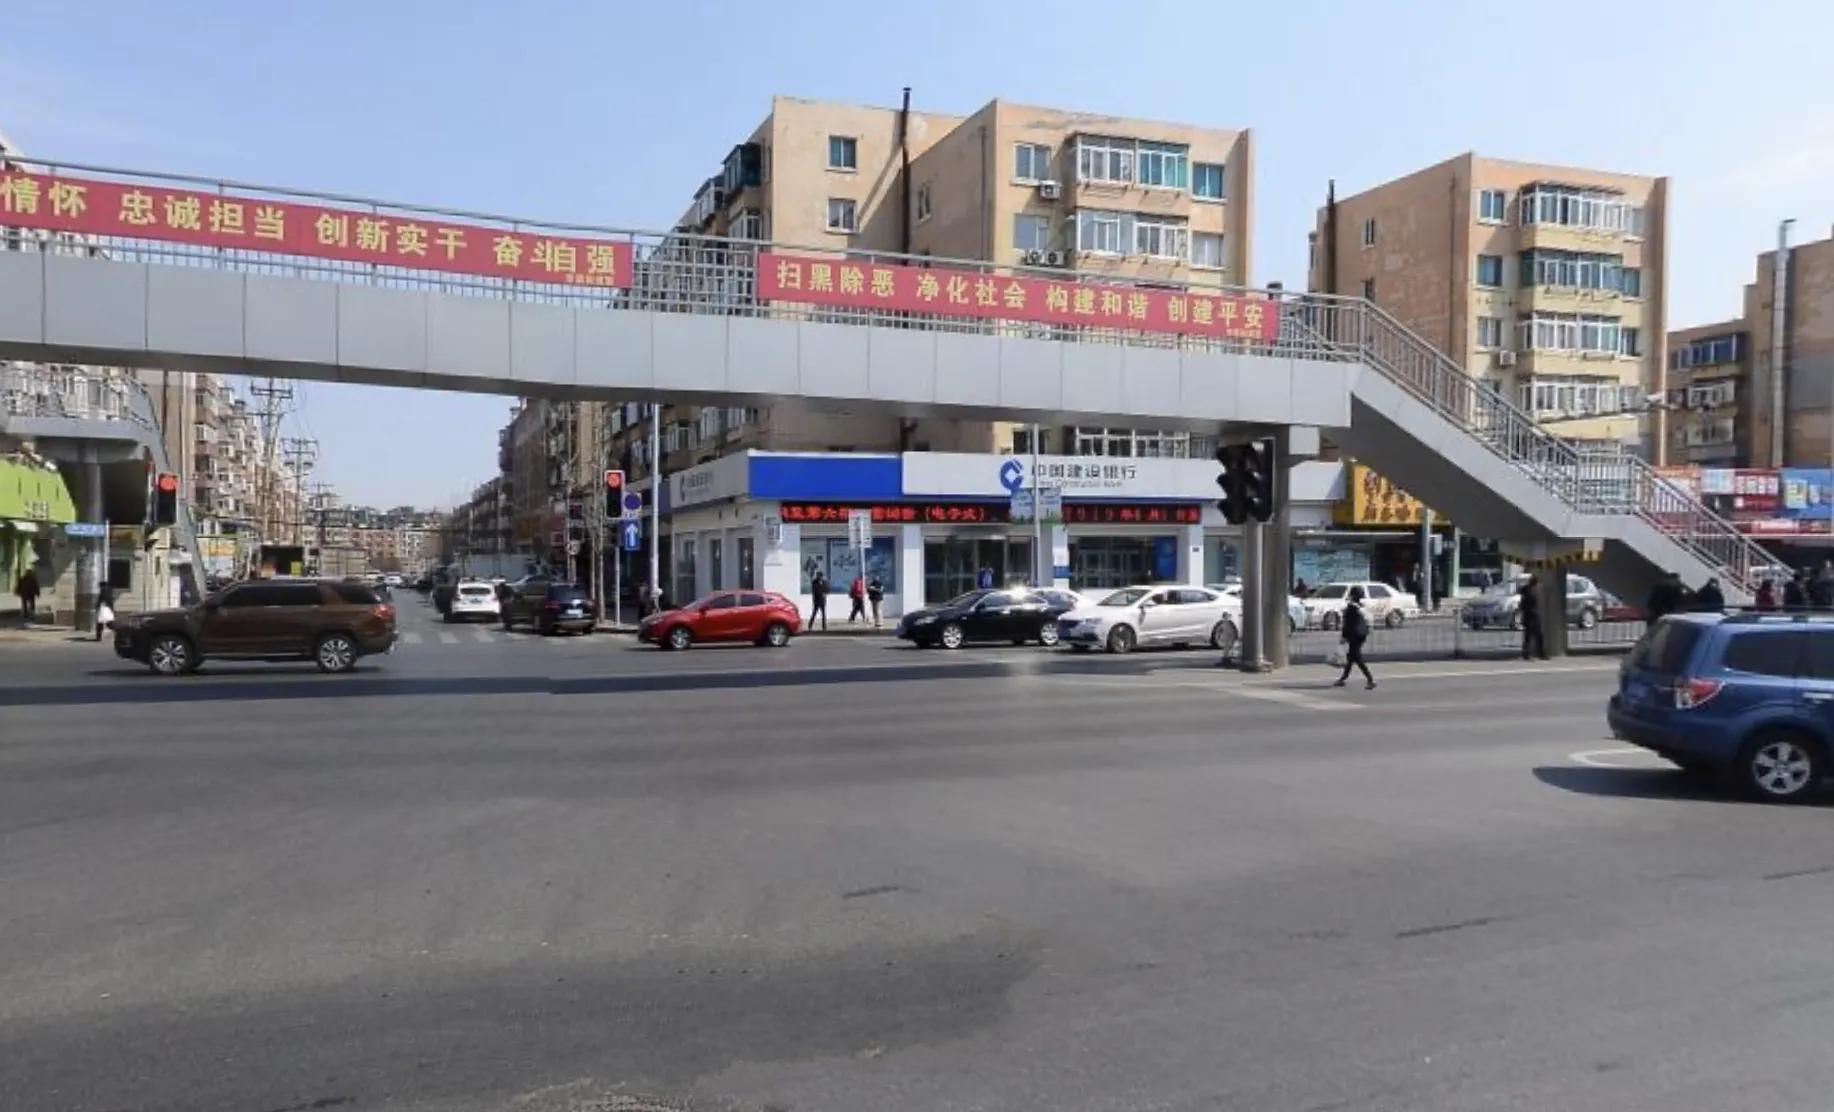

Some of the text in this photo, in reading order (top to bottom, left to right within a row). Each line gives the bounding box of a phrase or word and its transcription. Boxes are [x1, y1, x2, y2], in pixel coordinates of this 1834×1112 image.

[0, 176, 615, 275] 情怀 忠诚担当 创新实干 奋斗自强
[777, 259, 1264, 329] 扫黑除恶 净化社会 构建和谐 创建平安
